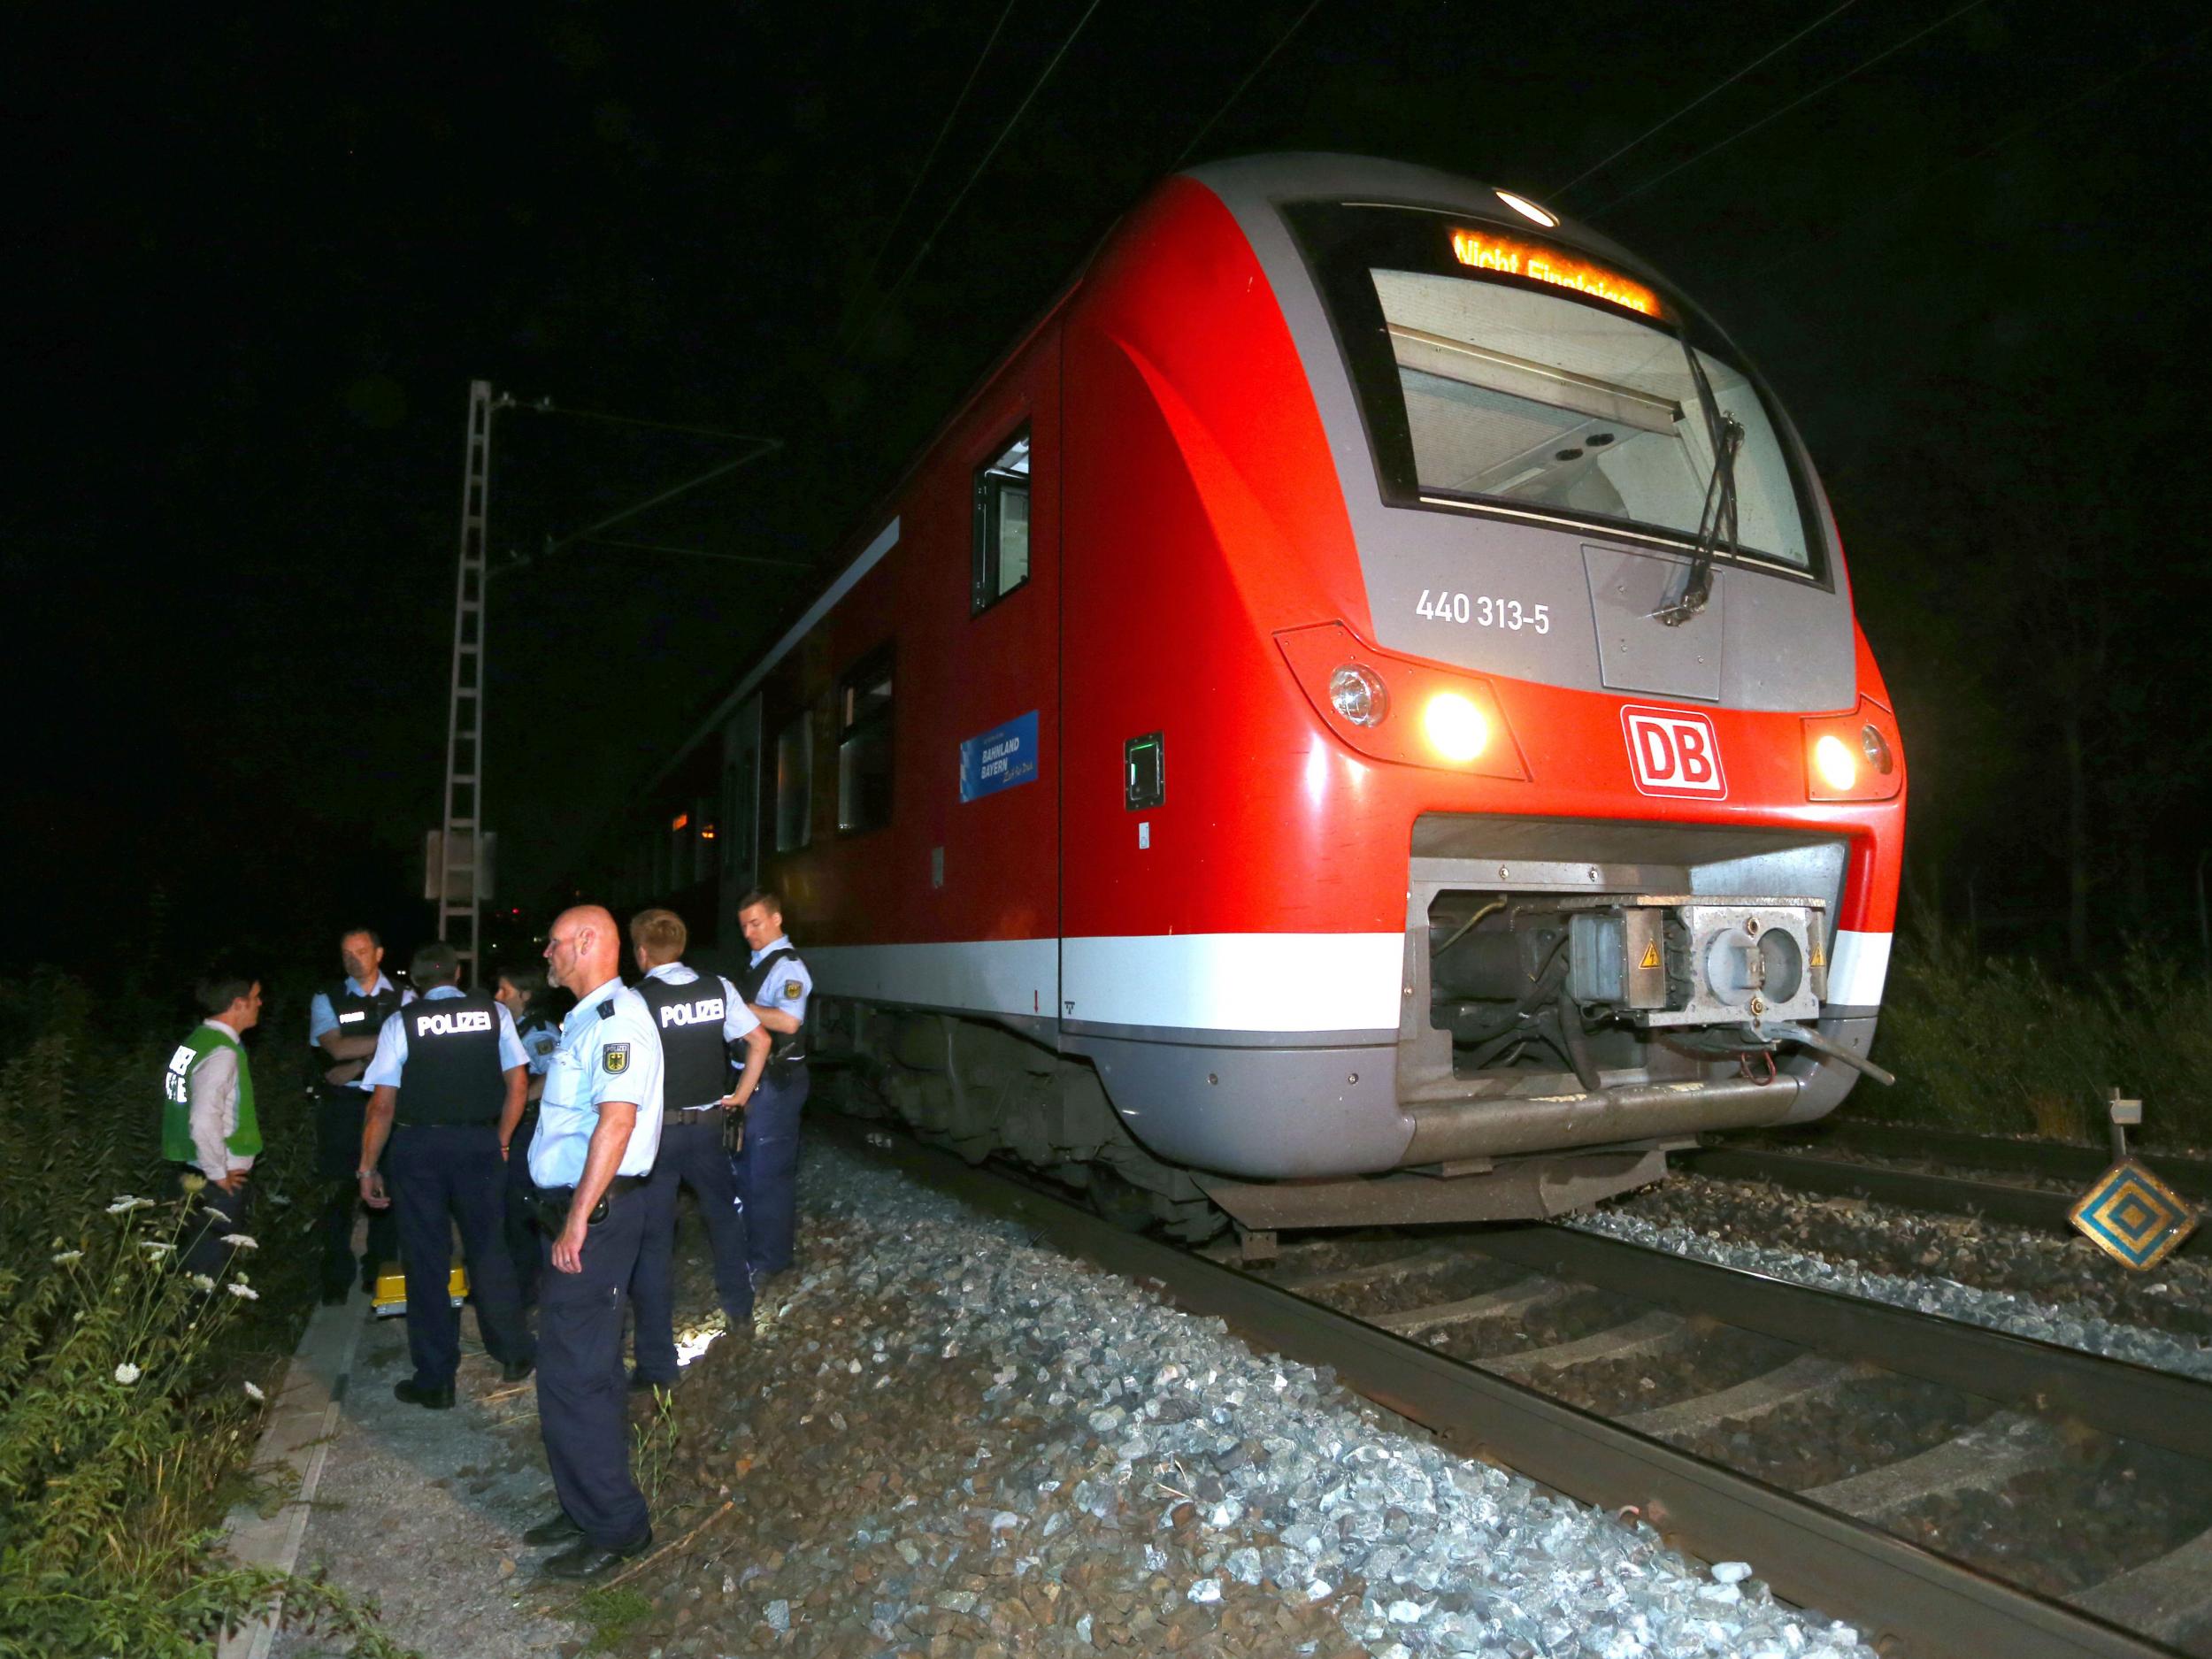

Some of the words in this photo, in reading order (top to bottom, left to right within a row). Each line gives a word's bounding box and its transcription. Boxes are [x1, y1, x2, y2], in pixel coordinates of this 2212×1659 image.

[1454, 234, 1518, 273] Nicht
[1416, 589, 1470, 624] 440
[1477, 595, 1549, 634] 313-5
[981, 737, 1019, 764] BAHNLAND
[1635, 721, 1712, 783] DB
[980, 757, 1008, 780] BAYERN
[418, 1011, 492, 1037] POLIZEI
[660, 998, 725, 1028] POLIZEI
